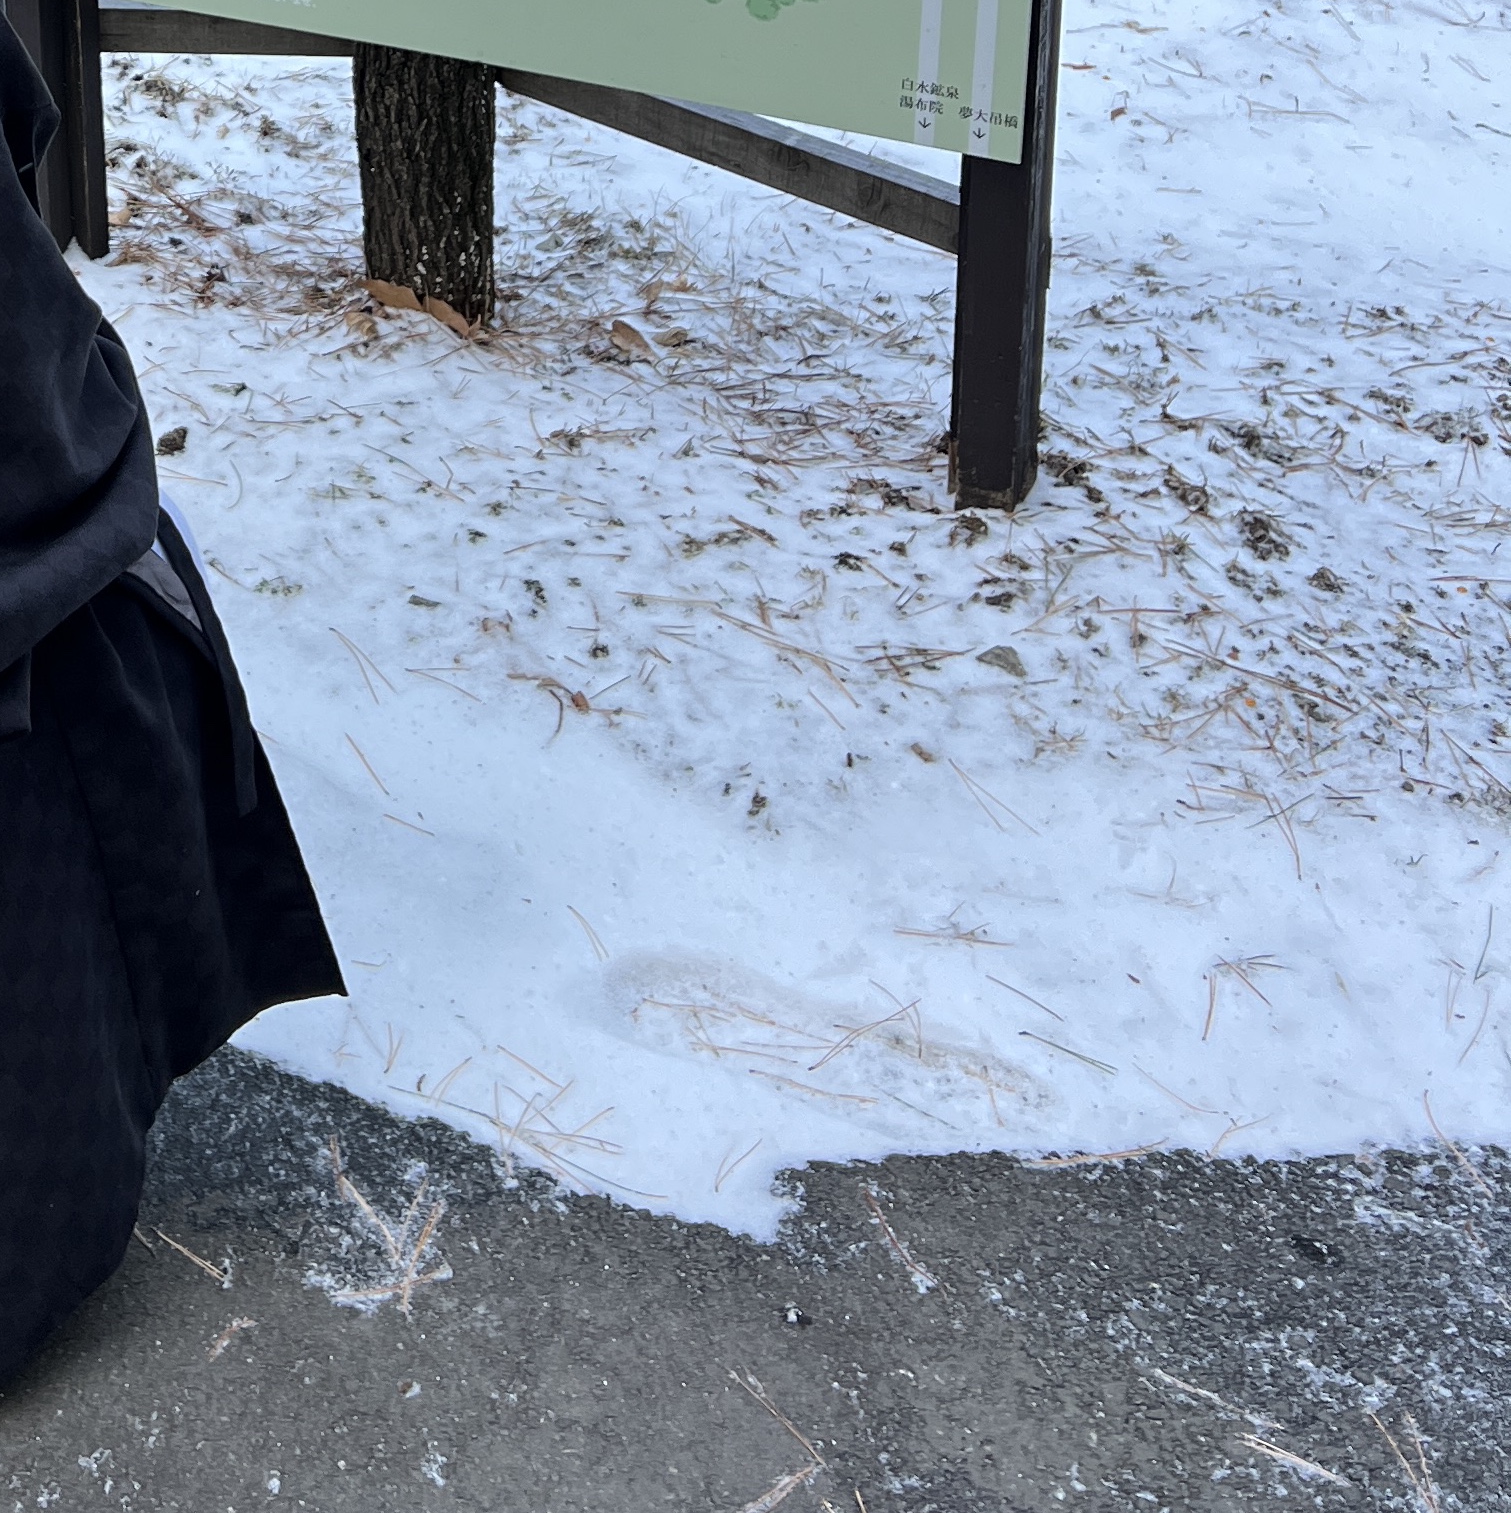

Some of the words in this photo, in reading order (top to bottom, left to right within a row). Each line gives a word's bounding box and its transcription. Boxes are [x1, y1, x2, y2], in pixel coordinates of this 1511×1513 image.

[901, 77, 959, 100] 白水鉱泉
[899, 95, 944, 115] 湯布院
[958, 105, 1019, 129] 夢大吊橋
